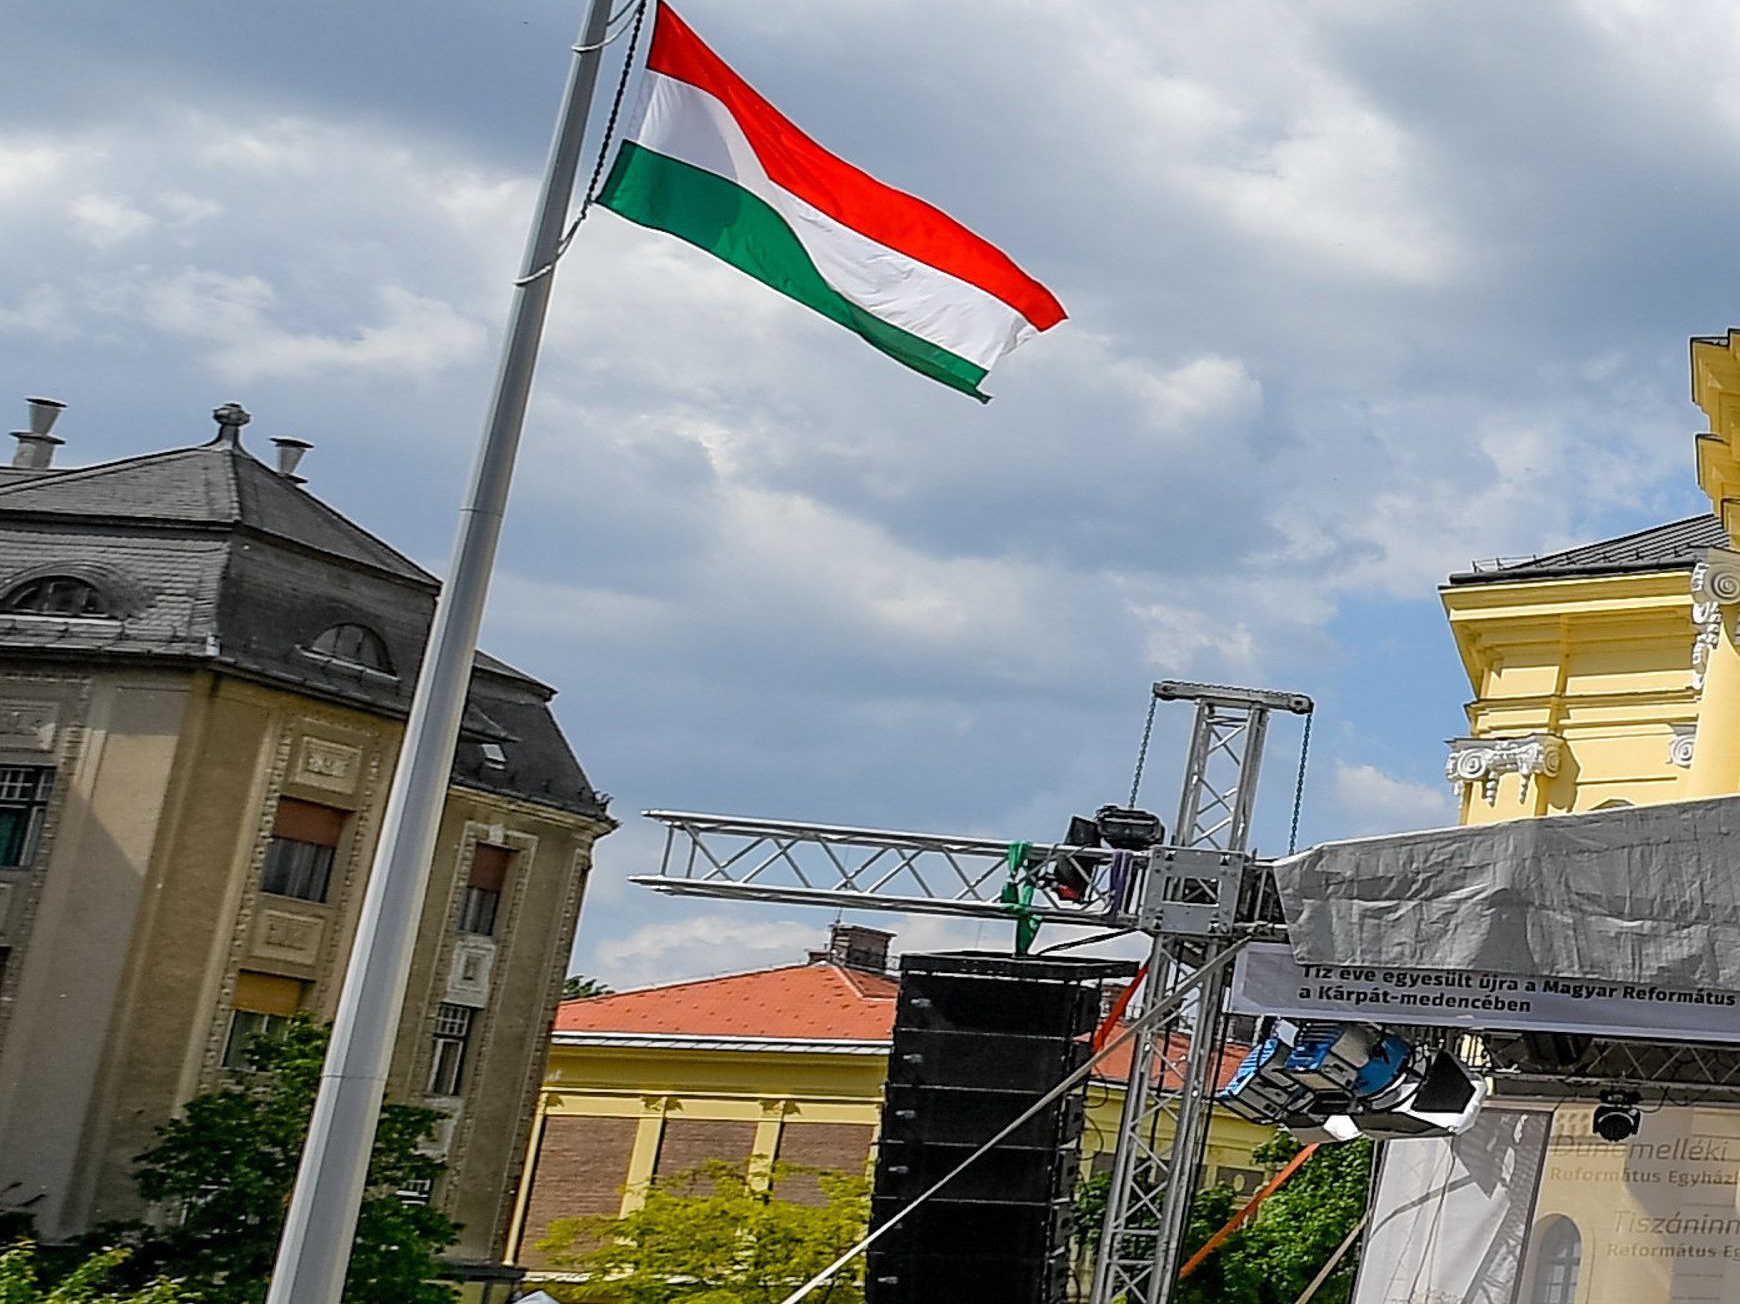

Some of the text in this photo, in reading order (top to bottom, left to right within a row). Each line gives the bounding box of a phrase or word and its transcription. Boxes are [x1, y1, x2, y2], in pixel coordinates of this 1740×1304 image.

[1298, 984, 1532, 1014] a Kárpát-medencében
[1382, 968, 1473, 989] egyesült
[1479, 972, 1519, 993] újra
[1524, 980, 1537, 993] a
[1542, 979, 1618, 1000] Magyar
[1622, 983, 1736, 1007] Református
[1550, 1166, 1661, 1184] Református
[1607, 1242, 1717, 1259] Református
